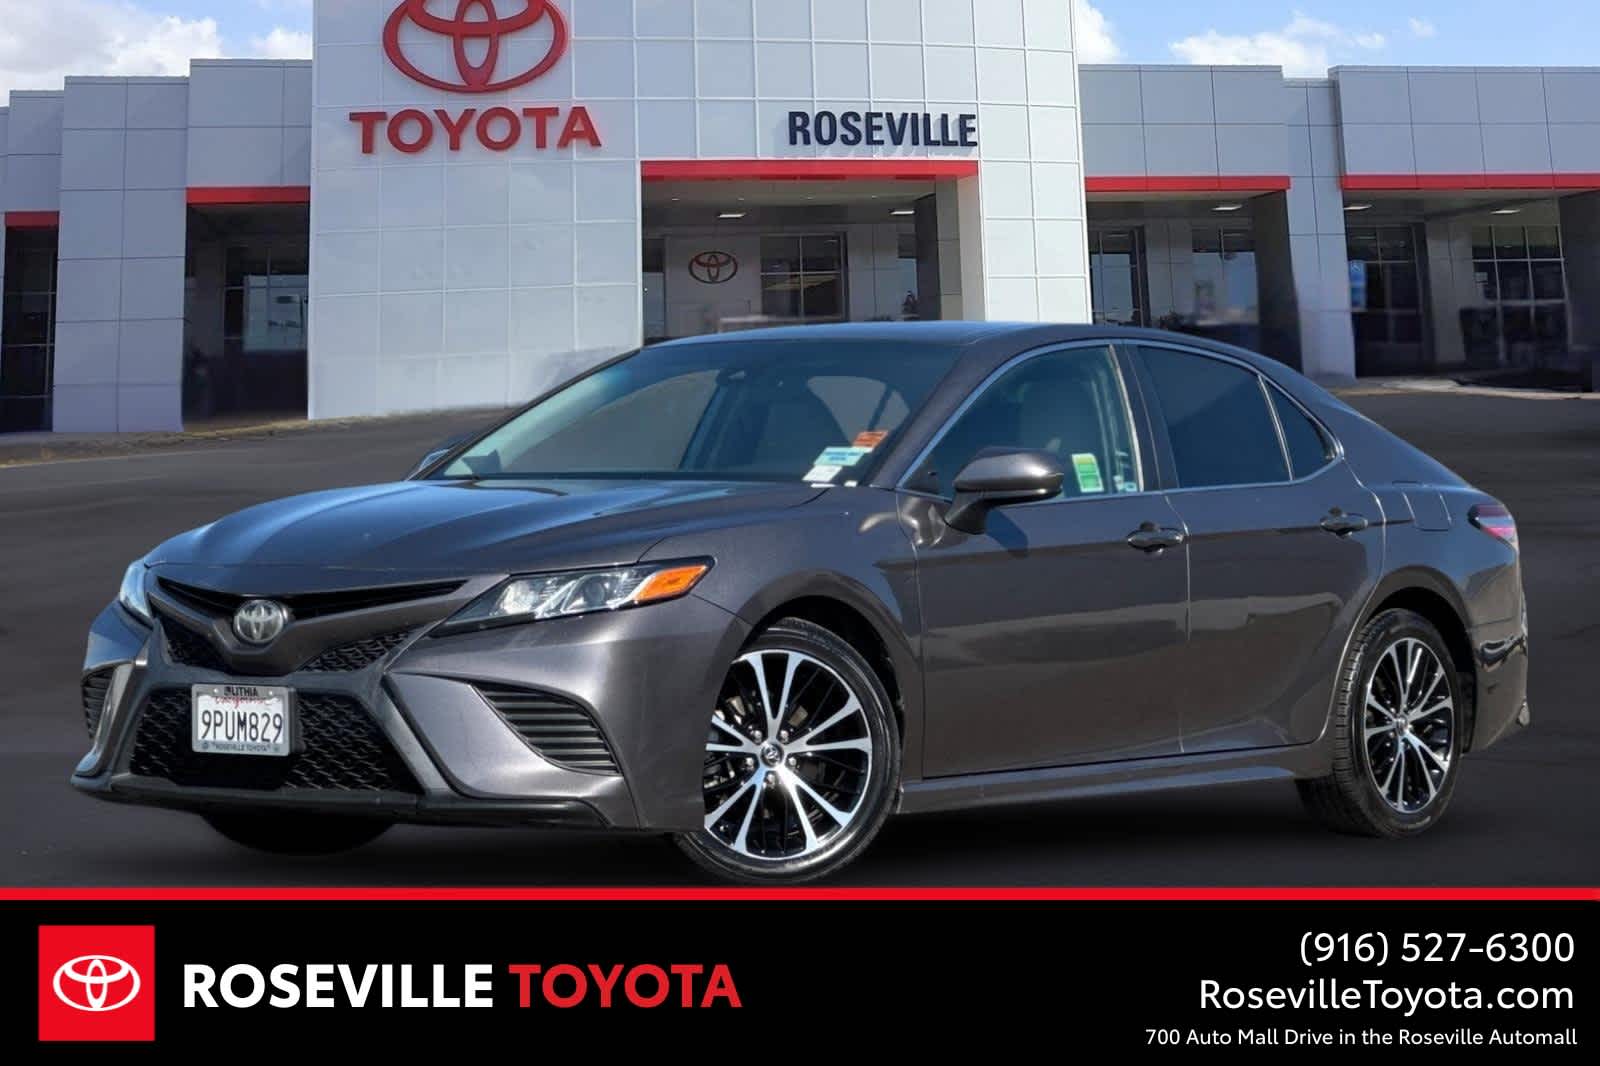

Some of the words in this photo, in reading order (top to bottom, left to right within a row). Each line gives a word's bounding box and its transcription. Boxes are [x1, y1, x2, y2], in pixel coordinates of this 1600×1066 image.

[349, 106, 602, 154] TOYOTA
[788, 110, 978, 147] ROSEVILLE
[231, 686, 258, 697] LITHIA
[201, 709, 283, 744] 9PUM829
